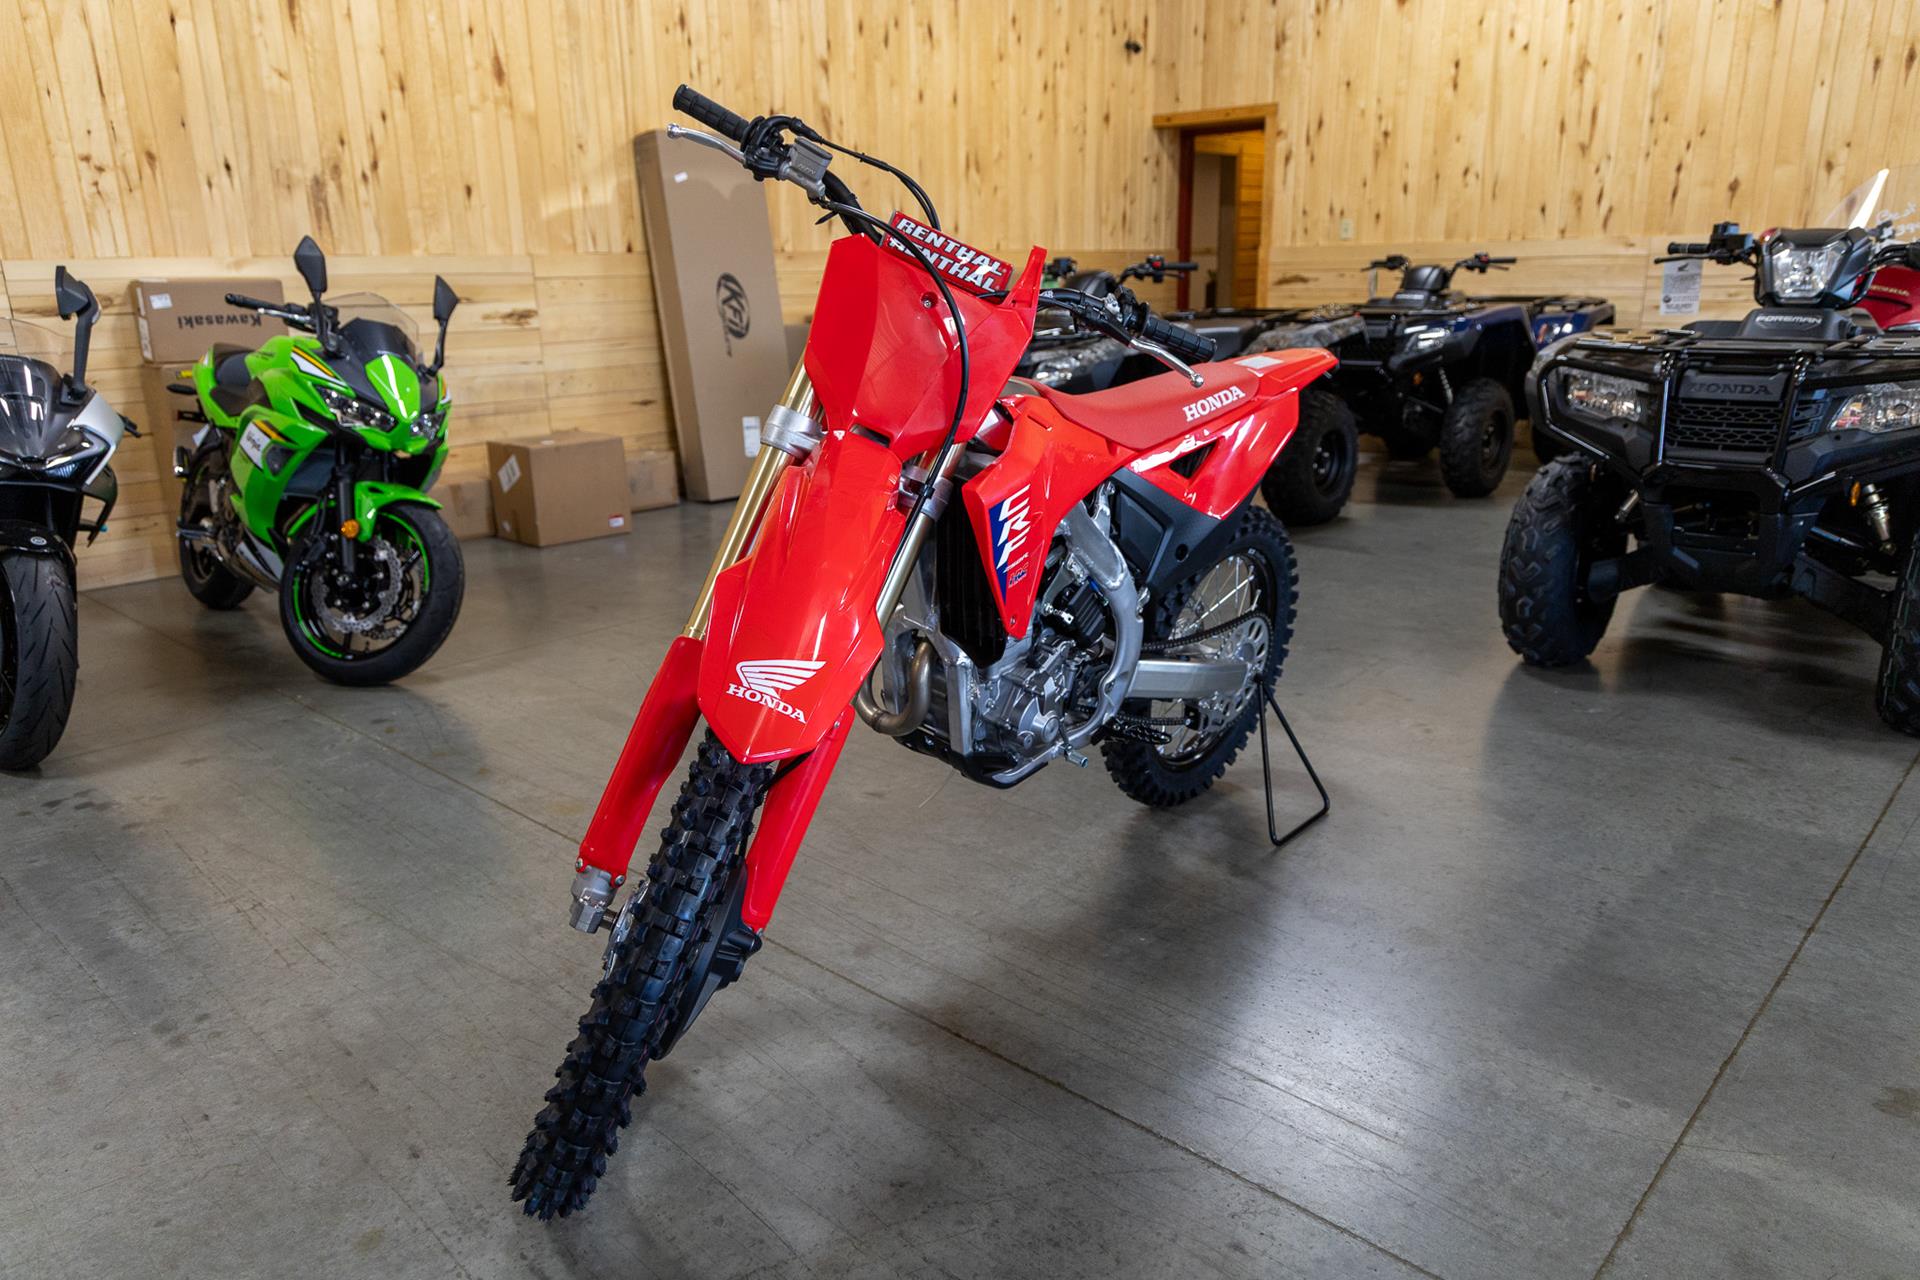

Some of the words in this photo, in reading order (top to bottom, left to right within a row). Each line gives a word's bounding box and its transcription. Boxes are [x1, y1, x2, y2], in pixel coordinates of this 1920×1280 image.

[897, 218, 1003, 276] RENTHAL
[177, 313, 262, 330] Kawasaki
[1755, 314, 1823, 324] FOREMAN
[1183, 385, 1246, 422] HONDA
[996, 483, 1031, 570] CRF
[726, 683, 807, 724] HONDA
